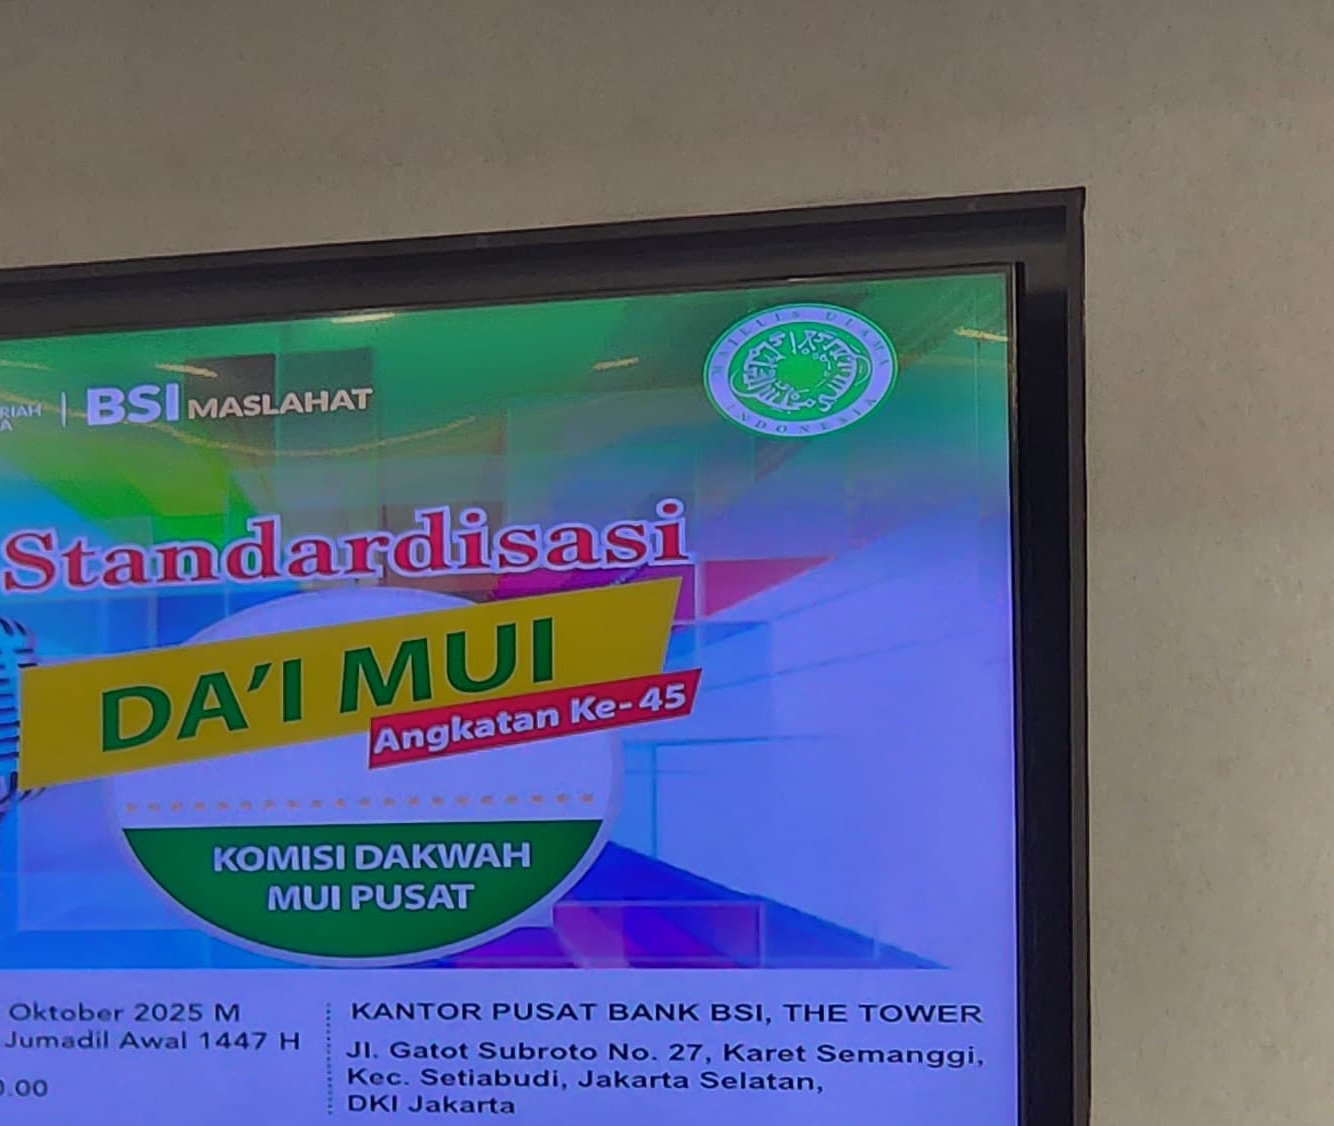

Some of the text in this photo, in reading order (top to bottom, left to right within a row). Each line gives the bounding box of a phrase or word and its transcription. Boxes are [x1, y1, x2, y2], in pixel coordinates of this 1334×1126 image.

[86, 382, 373, 427] BSI MASLAHAT
[1, 500, 691, 593] Standardisasi
[338, 616, 555, 714] MUI
[372, 707, 560, 755] Angkatan
[212, 842, 532, 872] KOMISI DAKWAH
[267, 883, 475, 911] MUI PUSAT
[8, 1000, 124, 1022] Oktober
[133, 1003, 203, 1022] 2025
[214, 1003, 240, 1023] M
[351, 1002, 984, 1025] KANTOR PUSAT BANK BSI, THE TOWER
[4, 1029, 109, 1049] Jumadil
[118, 1030, 187, 1049] Awal
[198, 1031, 268, 1051] 1447
[279, 1032, 300, 1051] H
[390, 1041, 469, 1060] Gatot
[478, 1041, 597, 1061] Subroto
[608, 1043, 658, 1061] No.
[669, 1043, 712, 1064] 27,
[723, 1043, 807, 1063] Karet
[817, 1044, 984, 1068] Semanggi,
[347, 1068, 824, 1093] Kec. Setiabudi, Jakarta Selatan,
[347, 1094, 516, 1114] DKI Jakarta
